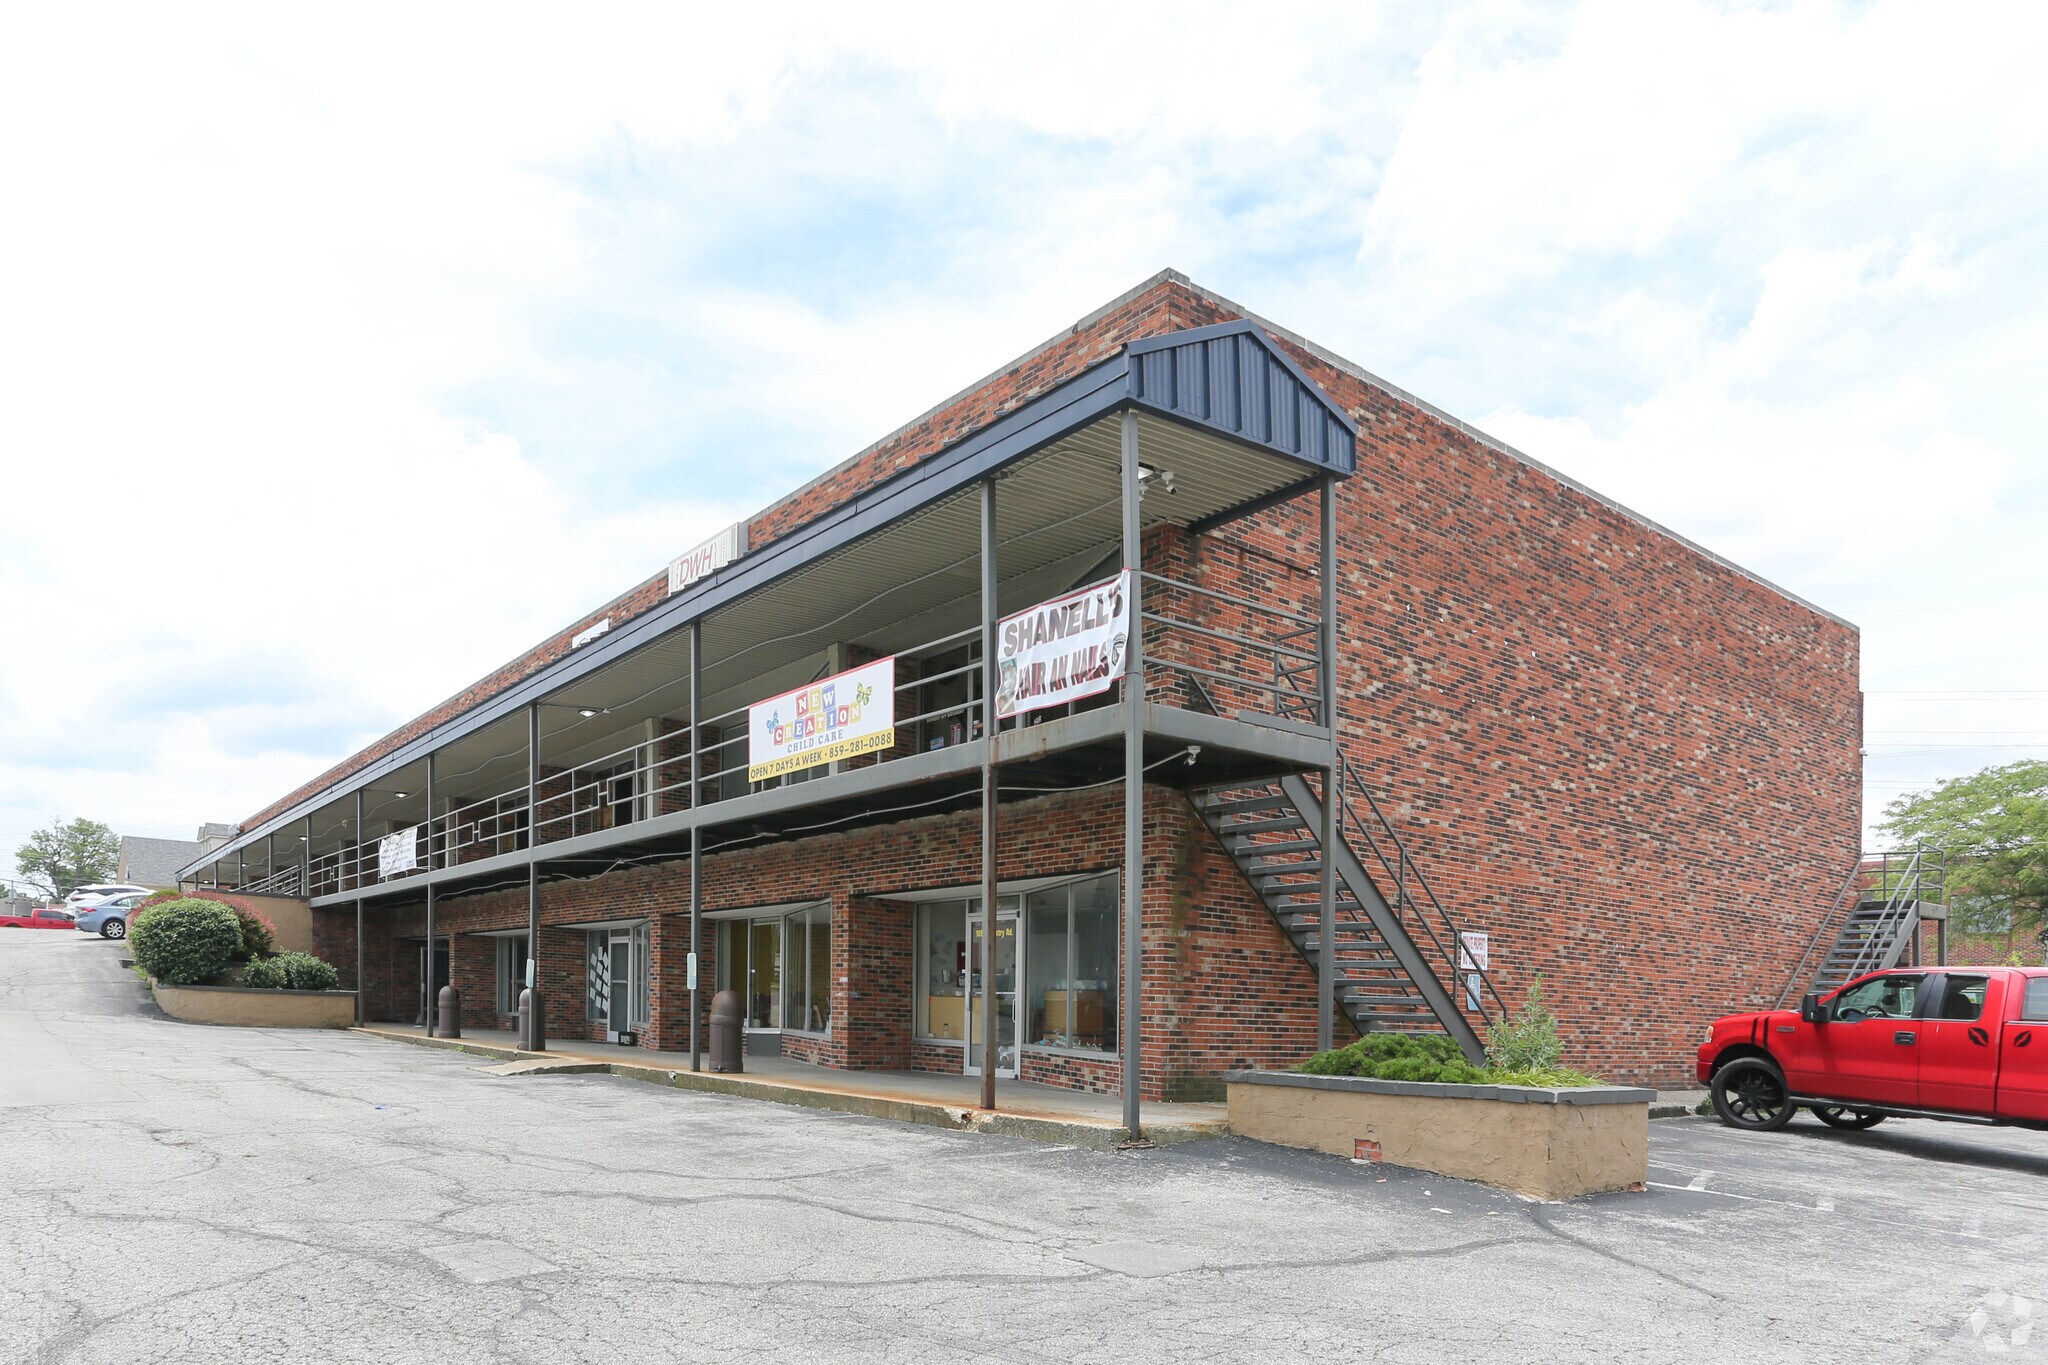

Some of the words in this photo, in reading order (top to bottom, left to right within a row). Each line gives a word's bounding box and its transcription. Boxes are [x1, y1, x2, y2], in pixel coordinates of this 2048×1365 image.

[680, 543, 713, 585] DWH
[797, 690, 836, 713] NEW
[775, 704, 861, 743] CREATION
[787, 738, 814, 753] CHILD
[818, 729, 844, 744] CARE
[750, 767, 768, 779] OPEN
[770, 764, 774, 774] 7
[775, 759, 793, 772] DAYS
[795, 757, 801, 768] A
[802, 750, 823, 765] WEEK
[829, 732, 892, 758] 859-281-0088
